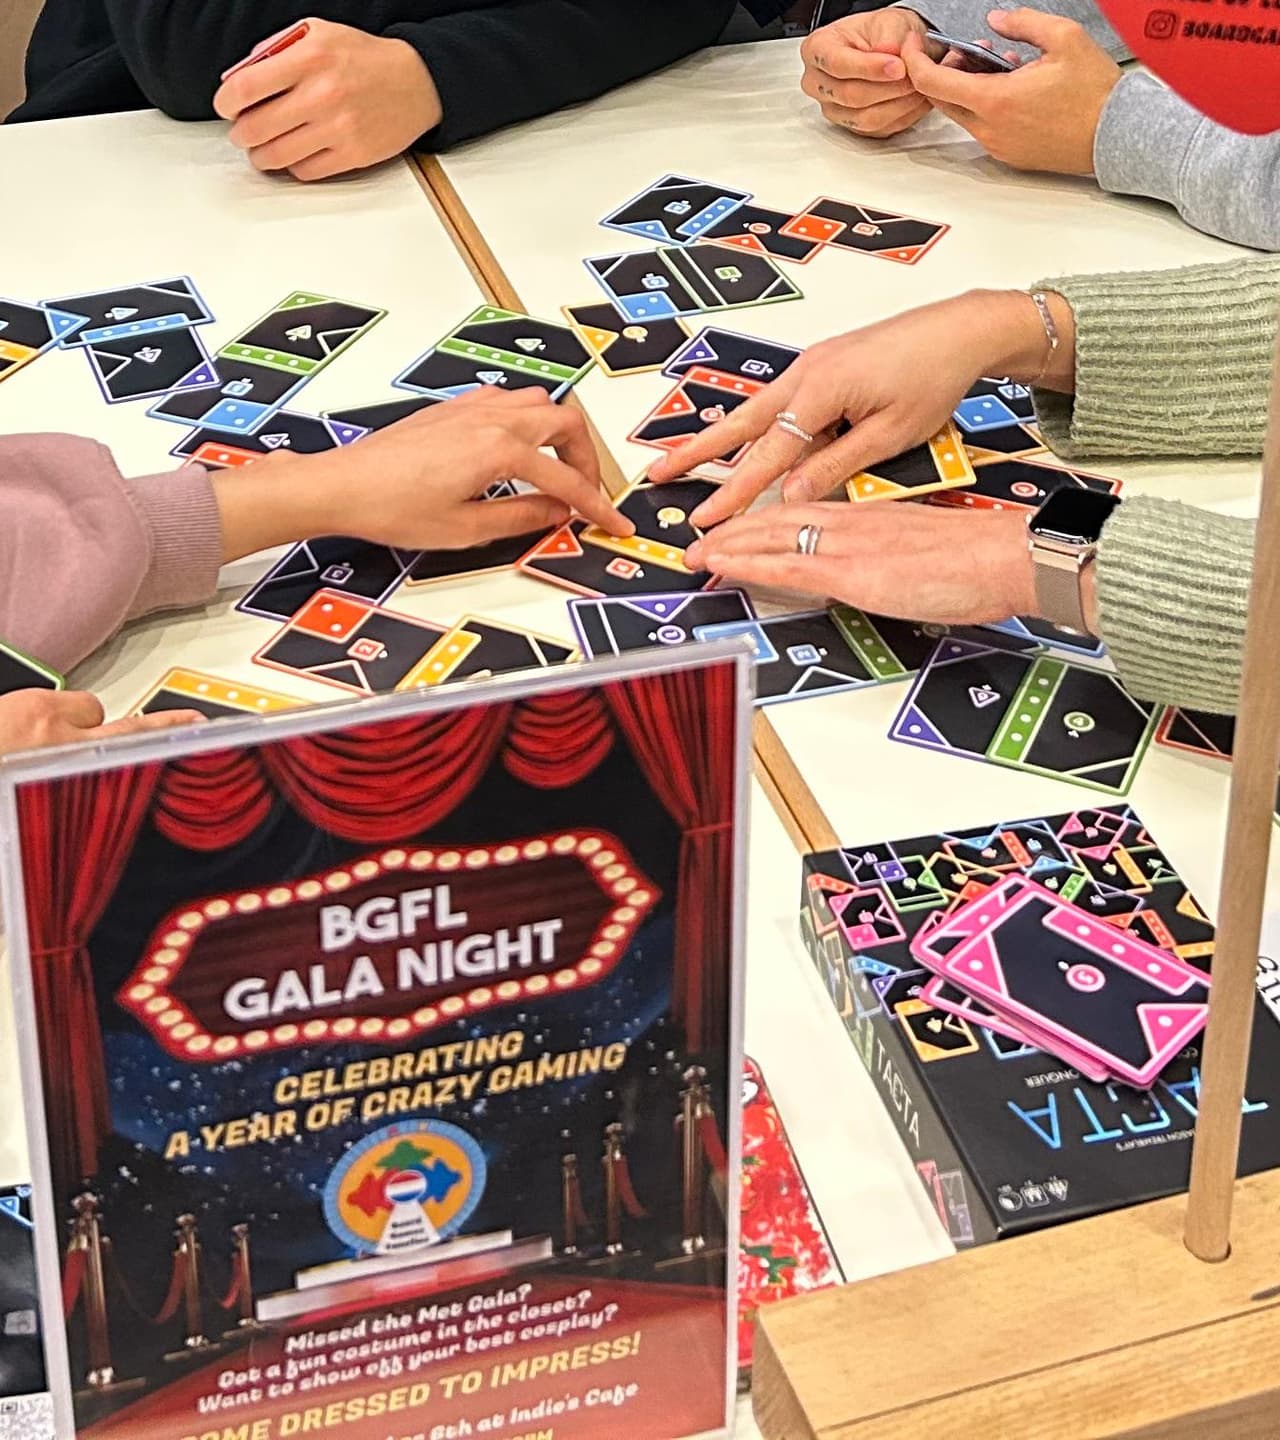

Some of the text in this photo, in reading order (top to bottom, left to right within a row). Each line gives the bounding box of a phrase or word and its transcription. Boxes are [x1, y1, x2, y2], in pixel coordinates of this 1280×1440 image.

[321, 885, 468, 952] BGFL
[224, 919, 563, 1022] GALA NIGHT
[165, 1042, 628, 1160] A YEAR OF CRAZY GAMING
[273, 1030, 525, 1105] CELEBRATING
[197, 1302, 619, 1414] Want to show off your best cosplay?
[218, 1289, 593, 1389] Got a fun costume in the closet?
[285, 1283, 533, 1354] Missed the Met Gala?
[280, 1382, 431, 1437] DRESSED
[439, 1370, 483, 1400] TO
[490, 1330, 642, 1389] IMPRESS!
[477, 1412, 505, 1432] at
[510, 1393, 579, 1426] Indie's
